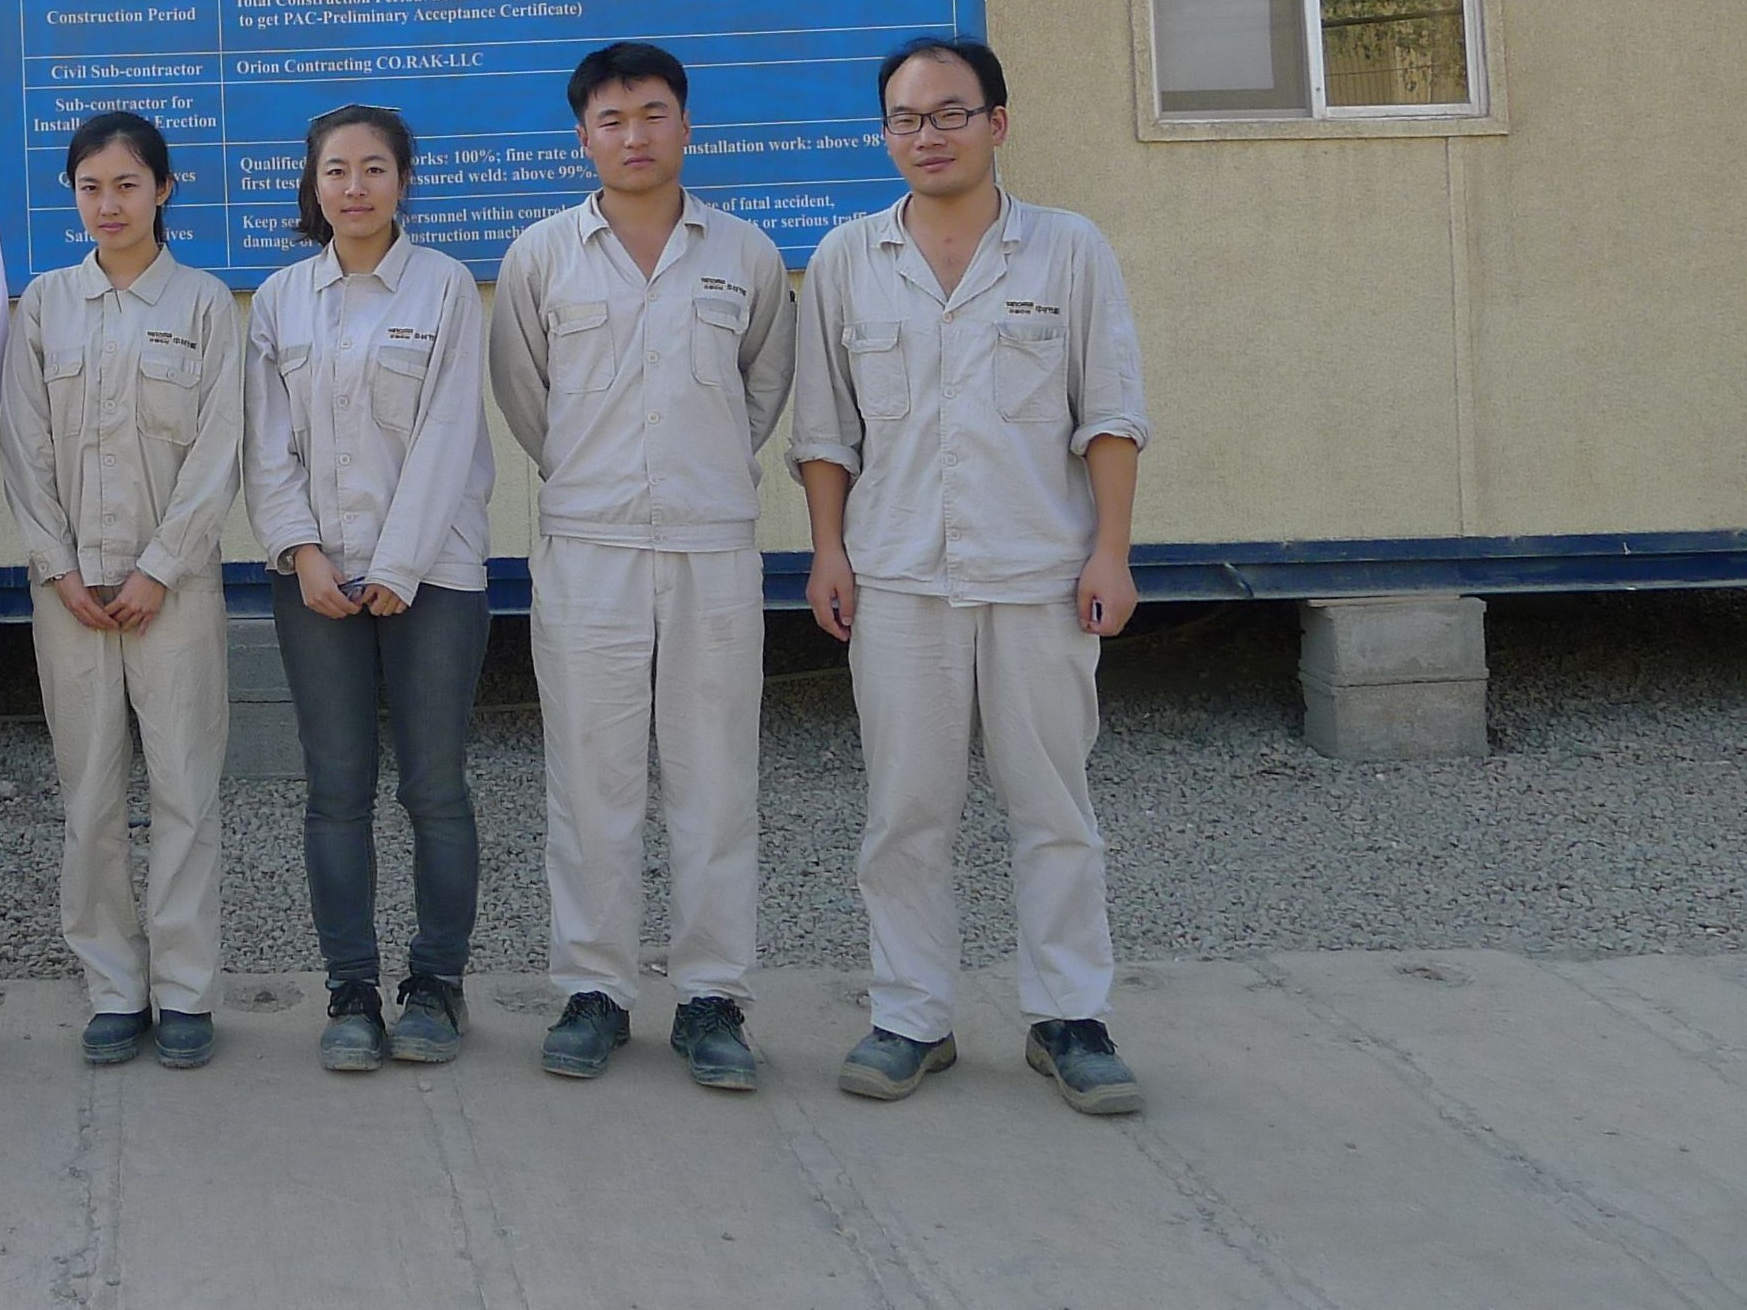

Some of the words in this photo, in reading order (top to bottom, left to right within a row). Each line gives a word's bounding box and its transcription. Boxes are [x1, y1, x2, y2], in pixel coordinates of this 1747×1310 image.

[46, 9, 143, 25] Construction
[148, 6, 196, 22] Period
[239, 14, 254, 27] to
[257, 14, 279, 30] get
[284, 9, 408, 26] PAC-Preliminary
[413, 7, 496, 24] Acceptance
[499, 1, 583, 18] Certificate)
[50, 64, 87, 80] Civil
[90, 64, 203, 79] Sub-contractor
[236, 60, 280, 74] Orion
[284, 57, 373, 74] Contracting
[375, 52, 483, 70] CO.RAK-LLC
[55, 97, 168, 112] Sub-contractor
[171, 95, 194, 109] for
[34, 117, 84, 132] Install
[155, 114, 217, 129] Erection
[410, 151, 449, 166] orks:
[454, 149, 502, 165] 100%;
[506, 147, 533, 162] fine
[538, 147, 567, 160] rate
[768, 136, 812, 151] work:
[816, 134, 859, 149] above
[862, 133, 887, 147] 98
[241, 177, 271, 191] first
[409, 169, 463, 186] essured
[468, 166, 507, 183] weld:
[512, 167, 555, 182] above
[558, 164, 598, 179] 99%.
[242, 215, 277, 232] Keep
[402, 207, 467, 228] personnel
[471, 206, 514, 222] within
[723, 197, 737, 211] of
[740, 195, 770, 211] fatal
[774, 194, 835, 210] accident,
[410, 228, 480, 244] nstruction
[762, 217, 778, 229] or
[781, 214, 829, 228] serious
